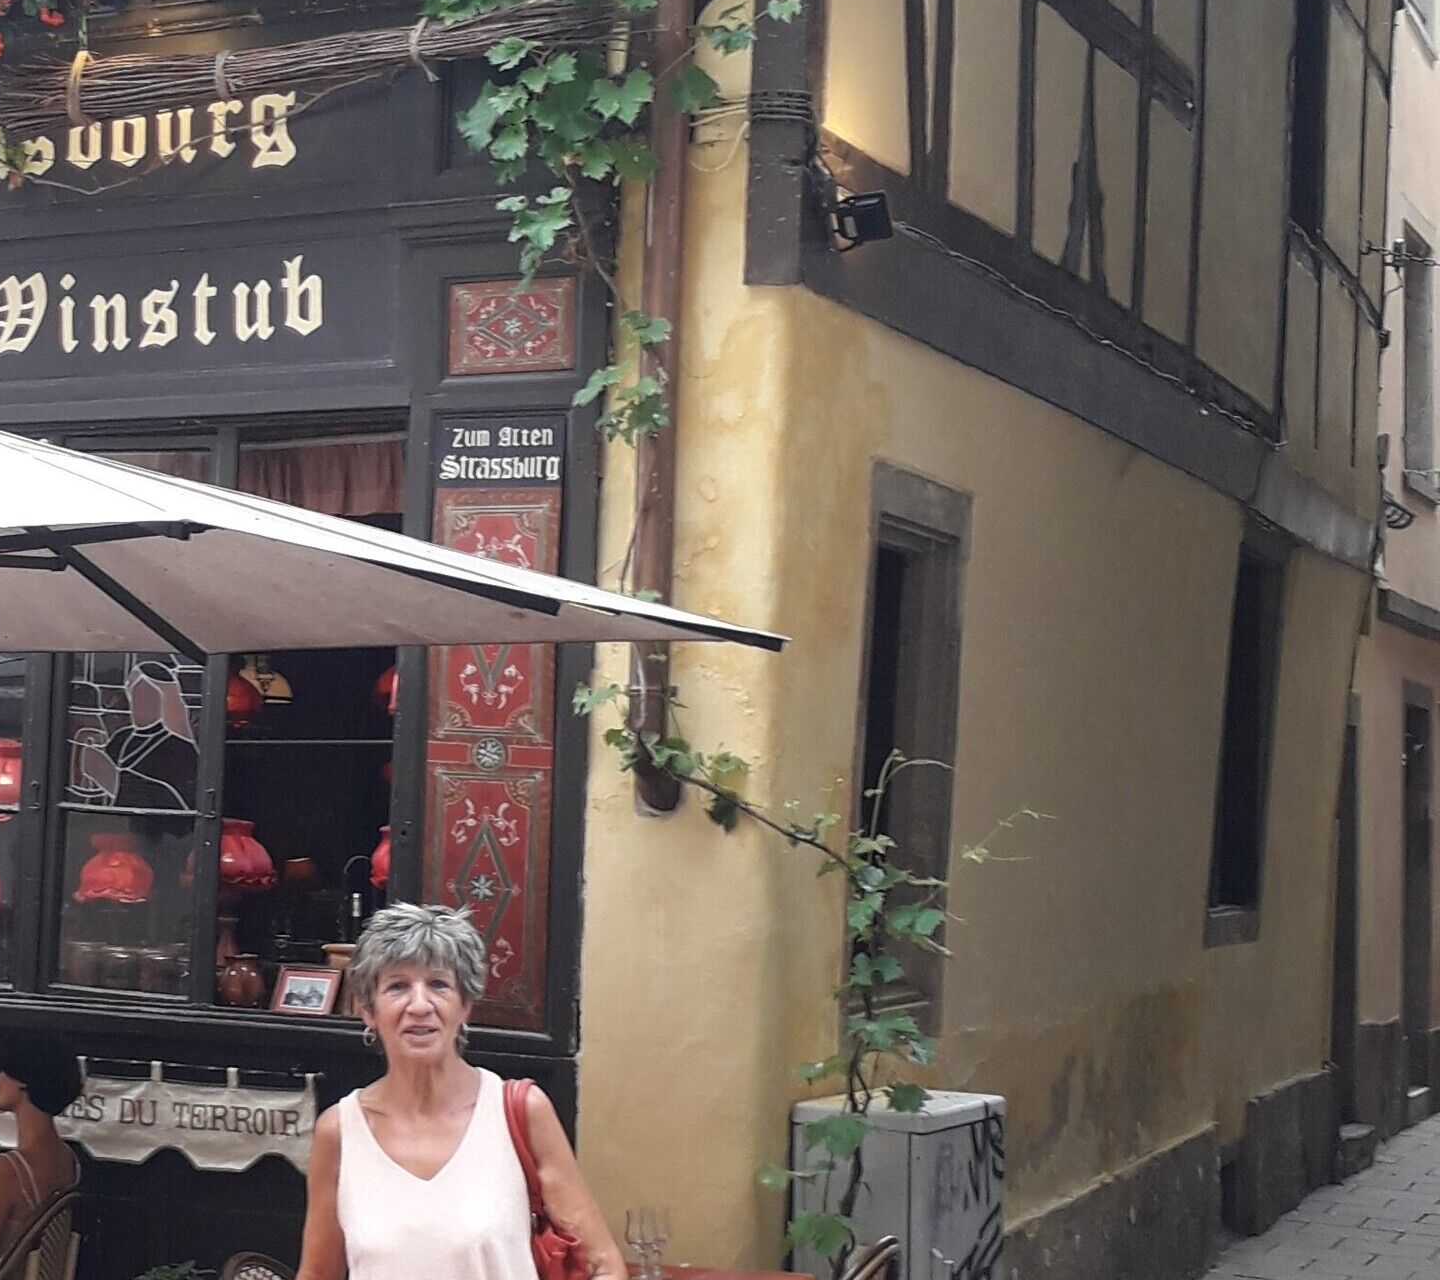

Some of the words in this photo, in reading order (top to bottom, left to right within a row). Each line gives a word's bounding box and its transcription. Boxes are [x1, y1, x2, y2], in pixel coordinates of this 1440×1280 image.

[451, 428, 490, 448] Zum
[439, 454, 560, 481] Strassburg
[120, 1097, 157, 1127] DU
[173, 1101, 302, 1137] TERROIR
